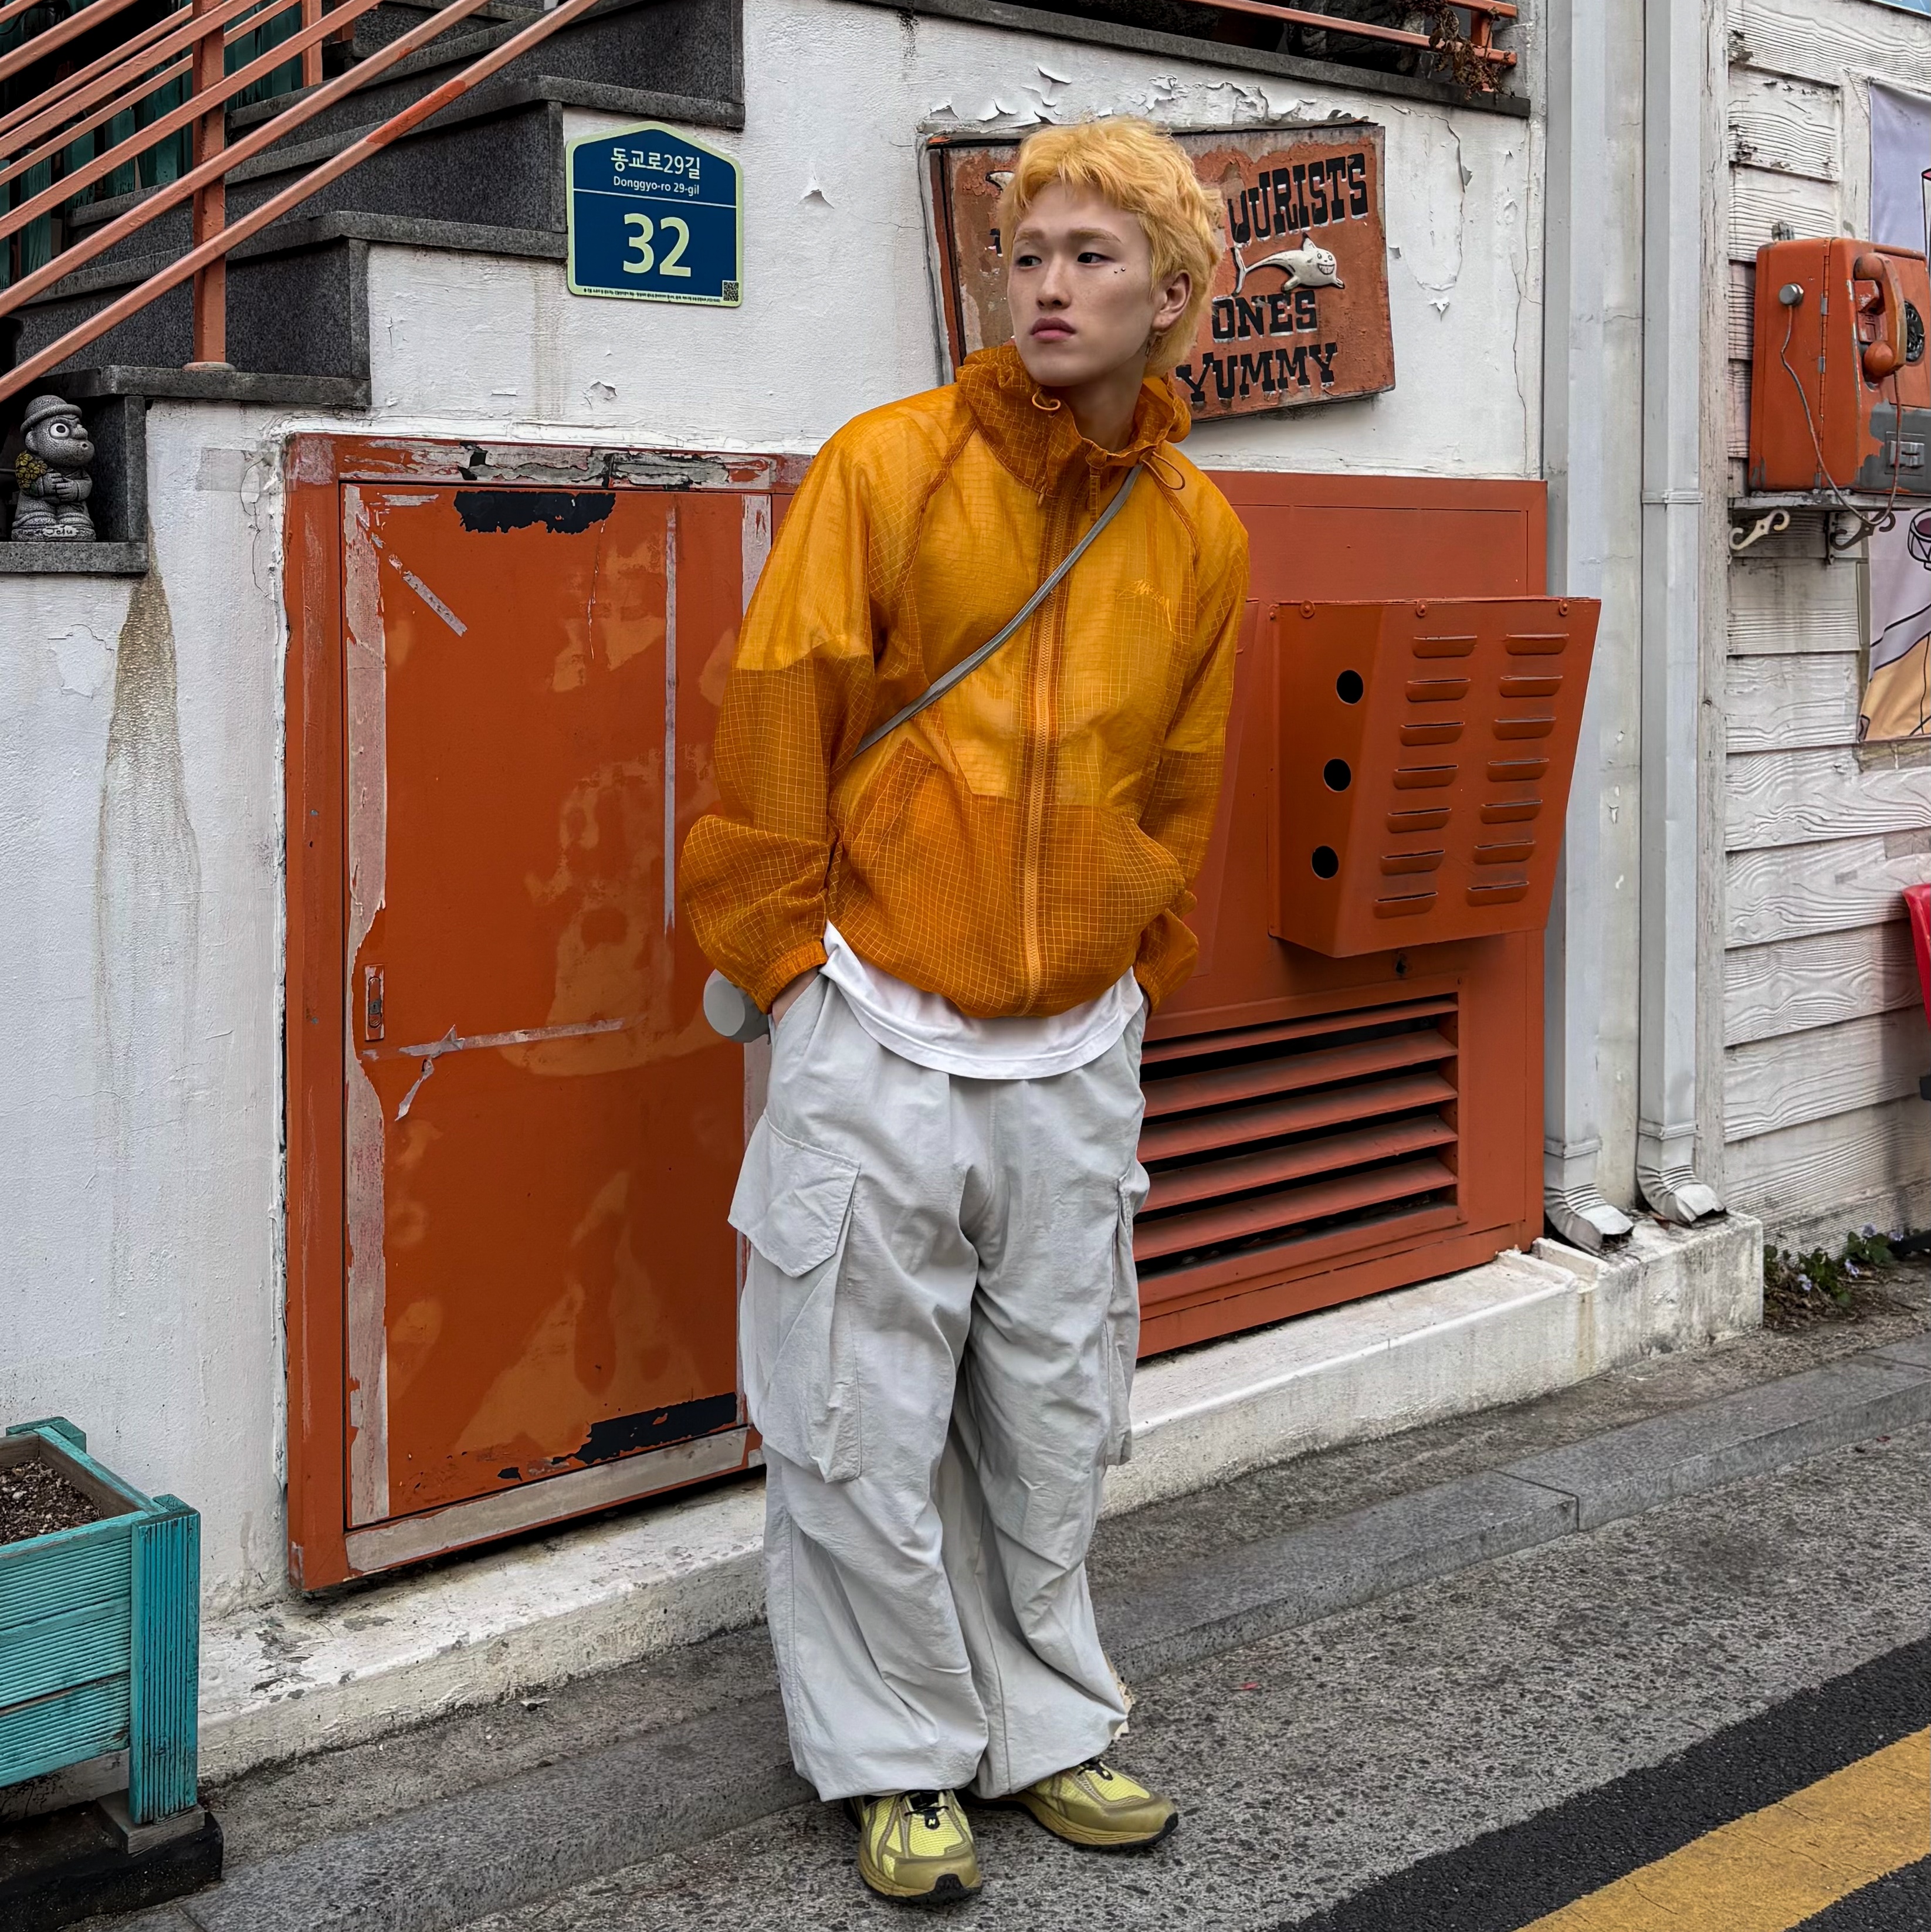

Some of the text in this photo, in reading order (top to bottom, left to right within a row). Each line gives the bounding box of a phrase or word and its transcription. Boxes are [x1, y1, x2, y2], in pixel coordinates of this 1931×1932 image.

[611, 147, 700, 179] 동교로29길
[614, 176, 699, 196] Donggyo-ro 29-gil
[1228, 152, 1368, 248] OURISTS
[623, 213, 691, 277] 32
[1175, 342, 1338, 405] YUMMY
